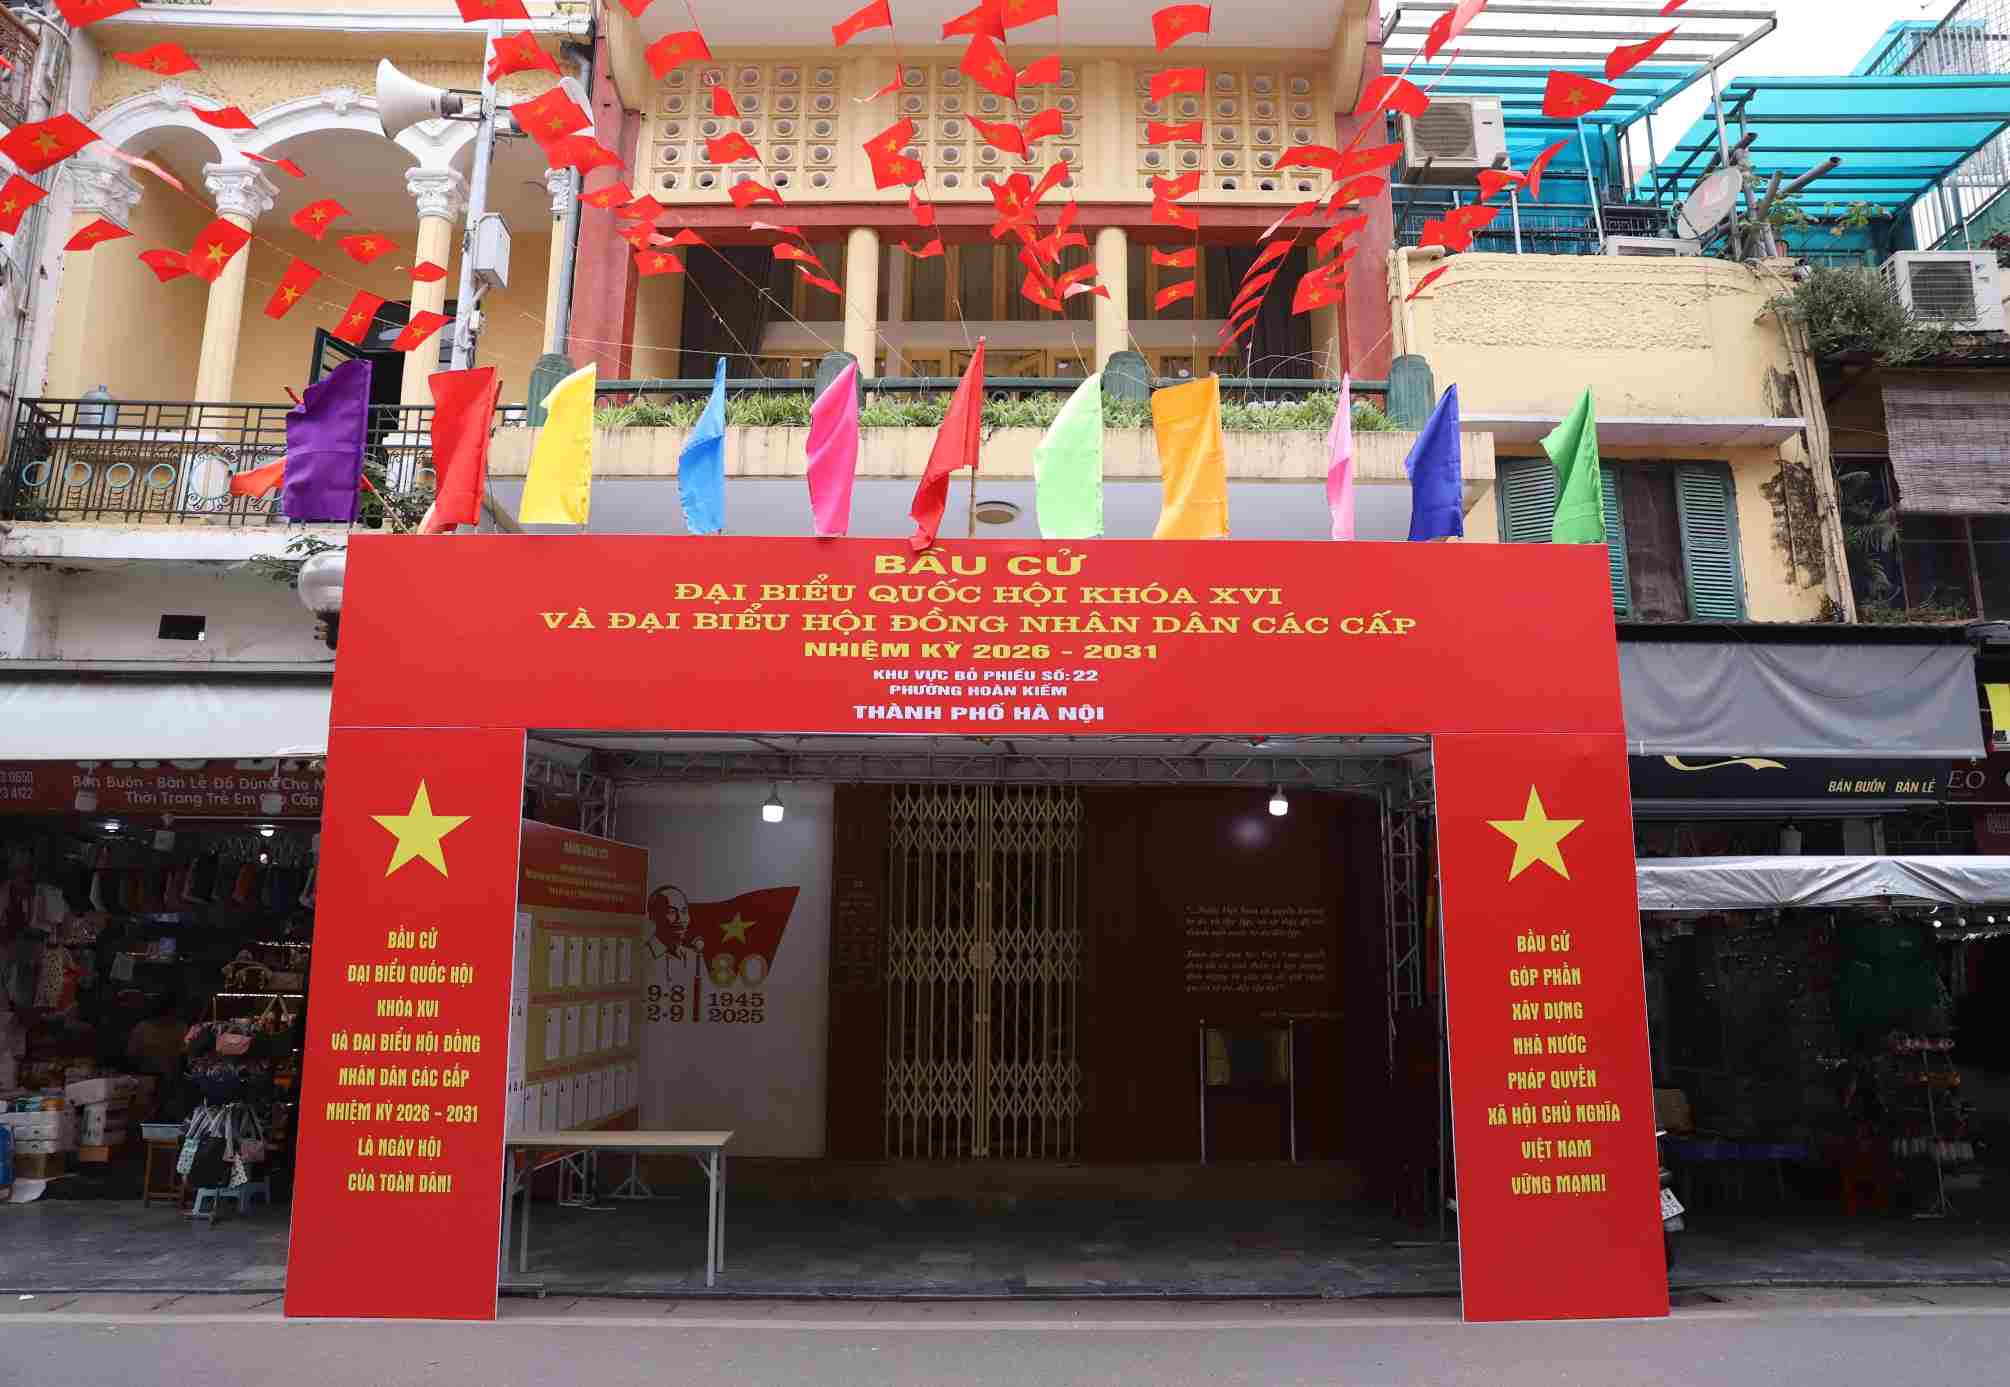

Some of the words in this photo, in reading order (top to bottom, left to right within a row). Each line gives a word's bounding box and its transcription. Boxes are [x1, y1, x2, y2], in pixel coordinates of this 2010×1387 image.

[874, 547, 987, 575] BẦU
[1007, 549, 1088, 576] CỬ
[675, 583, 746, 604] ĐẠI
[760, 574, 856, 602] BIỂU
[868, 578, 982, 604] QUỐC
[993, 582, 1068, 607] HỘI
[1080, 583, 1198, 605] KHÓA
[1209, 587, 1283, 605] XVI
[541, 608, 595, 630] VÀ
[608, 612, 680, 634] ĐẠI
[694, 603, 789, 632] BIỂU
[803, 609, 876, 636] HỘI
[891, 607, 1009, 633] ĐỒNG
[1019, 612, 1141, 634] NHÂN
[1153, 613, 1240, 634] DÂN
[1252, 613, 1329, 635] CÁC
[1340, 610, 1417, 635] CẤP
[804, 640, 910, 660] NHIỆM
[921, 641, 958, 660] KỲ
[973, 643, 1051, 660] 2026
[1084, 644, 1158, 660] 2031
[873, 670, 909, 681] KHU
[915, 670, 949, 682] VỰC
[955, 667, 978, 681] BỎ
[983, 667, 1036, 681] PHIẾU
[889, 683, 962, 696] PHƯỜNG
[968, 683, 1017, 696] HOÀN
[1023, 682, 1068, 696] KIẾM
[853, 702, 942, 720] THÀNH
[951, 700, 1005, 721] PHỐ
[1014, 703, 1050, 721] HÀ
[1058, 704, 1105, 724] NỘI
[1828, 779, 1851, 792] BÁN
[1895, 780, 1920, 792] BÁN
[387, 924, 415, 949] BẦU
[419, 926, 439, 949] CỬ
[1517, 928, 1546, 952] BẦU
[1551, 929, 1570, 952] CỬ
[375, 957, 405, 983] BIỂU
[410, 960, 446, 984] QUỐC
[450, 963, 473, 988] HỘI
[1510, 964, 1538, 986] GÓP
[1543, 962, 1581, 986] PHẦN
[377, 995, 413, 1017] KHÓA
[417, 1000, 439, 1017] XVI
[708, 992, 765, 1007] 1945
[1512, 1000, 1539, 1020] XÂY
[1544, 1000, 1583, 1023] DỰNG
[708, 1008, 765, 1024] 2025
[331, 1030, 348, 1051] VÀ
[352, 1033, 376, 1055] ĐẠI
[380, 1026, 411, 1052] BIỂU
[416, 1031, 439, 1055] HỘI
[443, 1028, 480, 1053] ĐỒNG
[1513, 1033, 1543, 1055] NHÀ
[1548, 1033, 1587, 1054] NƯỚC
[339, 1064, 375, 1086] NHÂN
[380, 1065, 407, 1087] DÂN
[412, 1065, 438, 1087] CÁC
[443, 1063, 470, 1088] CẤP
[1507, 1067, 1546, 1089] PHÁP
[1551, 1064, 1597, 1089] QUYỀN
[326, 1099, 371, 1124] NHIỆM
[376, 1099, 393, 1121] KỲ
[396, 1103, 430, 1122] 2026
[446, 1104, 478, 1122] 2031
[1488, 1103, 1507, 1125] XÃ
[1512, 1103, 1536, 1127] HỘI
[1542, 1100, 1571, 1123] CHỦ
[1576, 1100, 1621, 1123] NGHĨA
[358, 1135, 373, 1156] LÀ
[378, 1135, 414, 1157] NGÀY
[418, 1136, 441, 1160] HỘI
[1521, 1137, 1552, 1162] VIỆT
[1557, 1139, 1591, 1158] NAM
[348, 1168, 375, 1192] CỦA
[379, 1170, 414, 1192] TOÀN
[1512, 1172, 1552, 1195] VỮNG
[1556, 1174, 1606, 1197] MẠNH!
